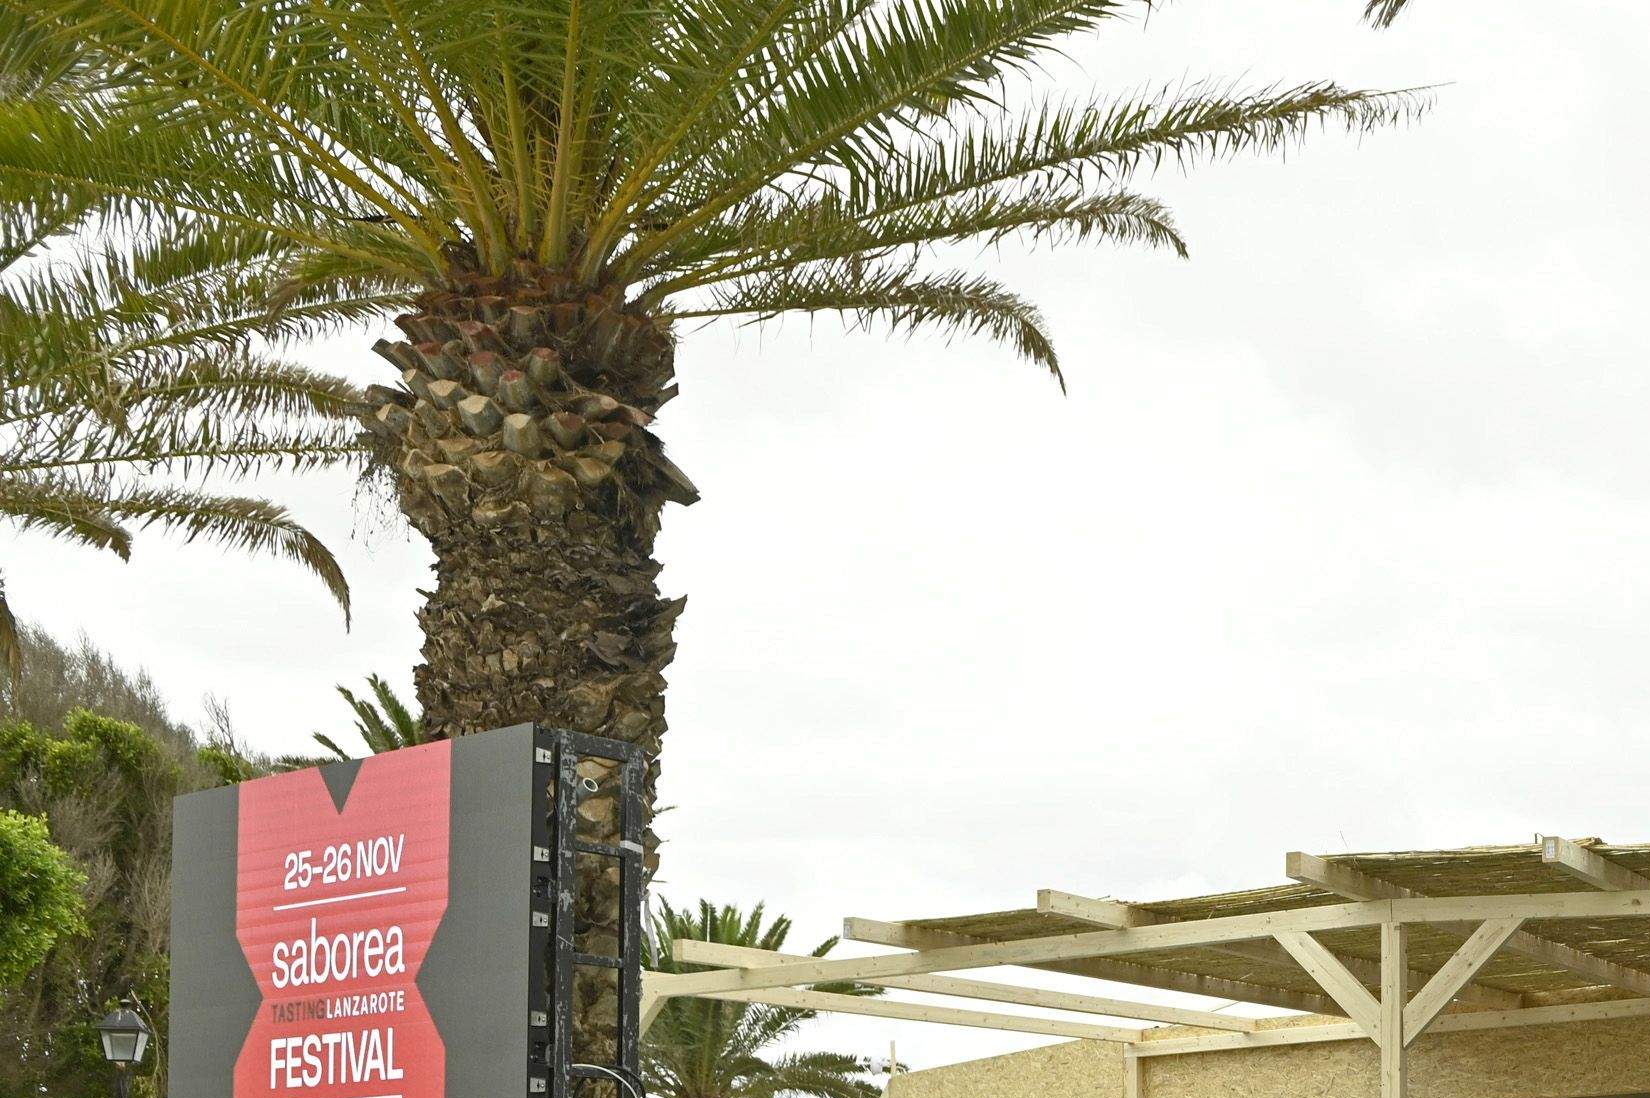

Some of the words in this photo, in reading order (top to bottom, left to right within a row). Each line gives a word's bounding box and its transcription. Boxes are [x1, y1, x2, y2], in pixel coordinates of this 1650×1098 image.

[283, 843, 352, 891] 25-26
[356, 833, 405, 879] NOV
[271, 917, 406, 989] saborea
[326, 990, 405, 1019] LANZAROTE
[269, 1027, 404, 1090] FESTIVAL
